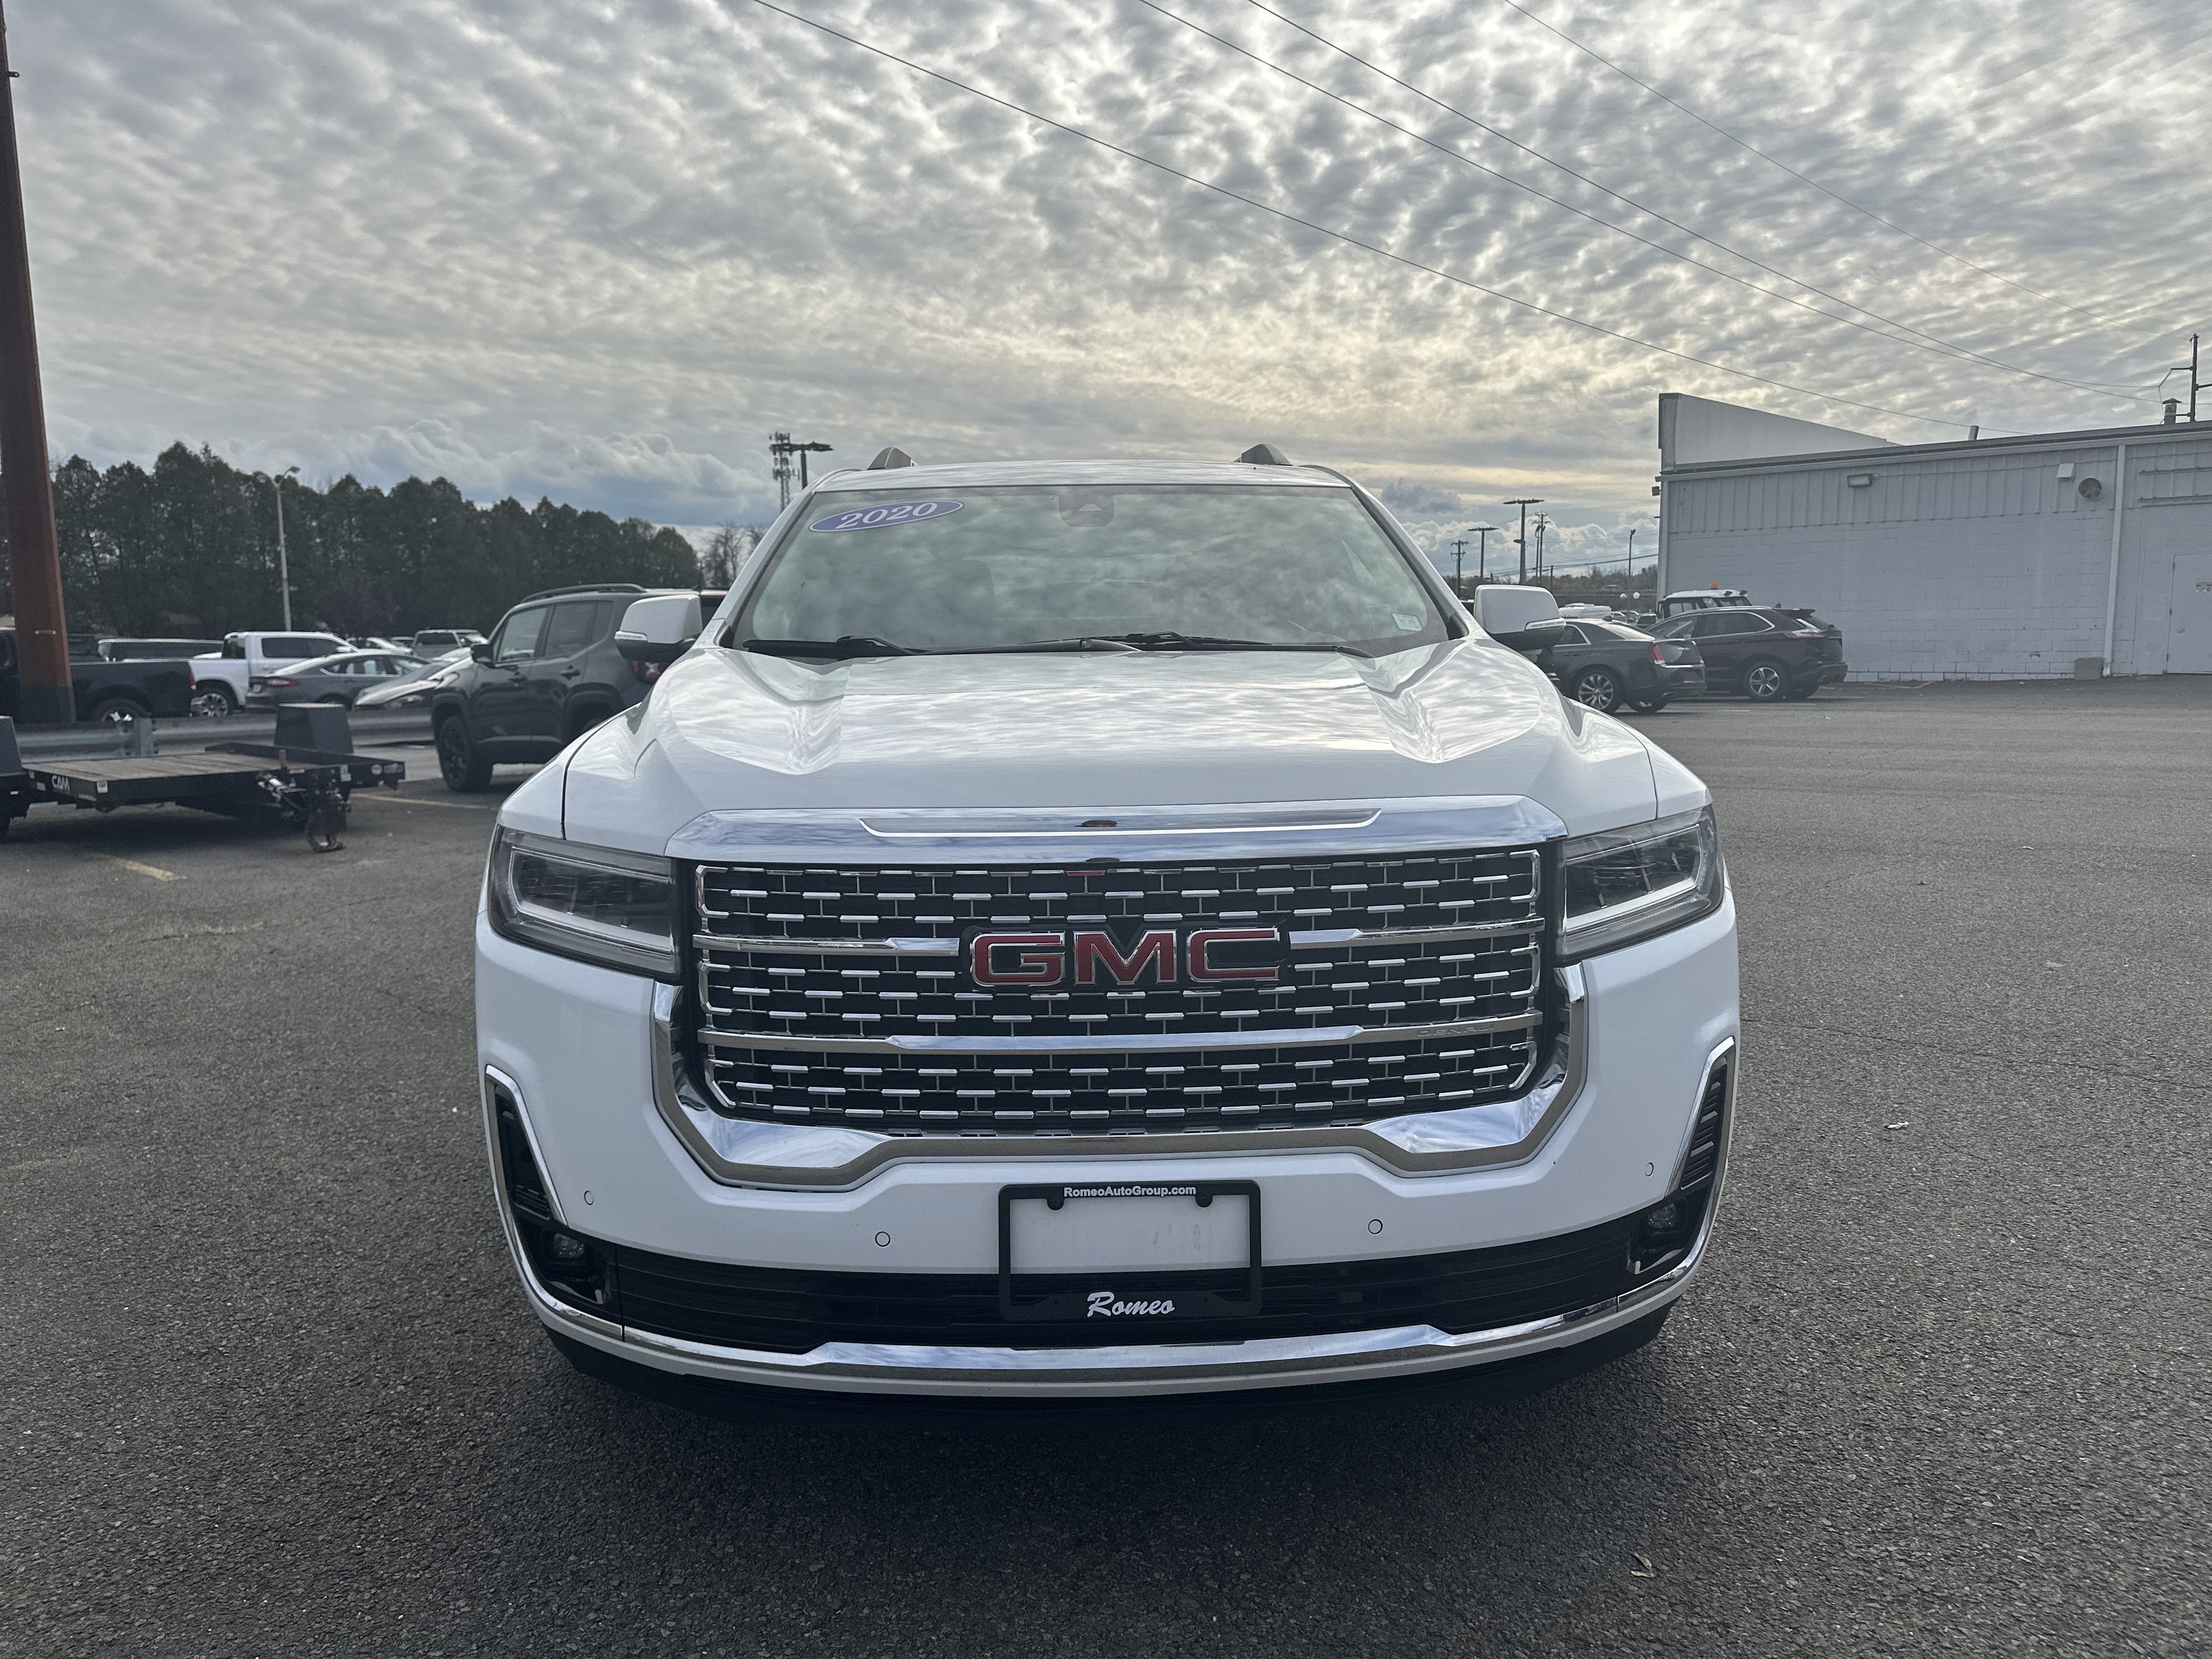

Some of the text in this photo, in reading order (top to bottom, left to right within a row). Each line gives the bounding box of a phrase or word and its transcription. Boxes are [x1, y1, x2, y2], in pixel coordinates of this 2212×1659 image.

[835, 503, 938, 529] 2020
[52, 775, 70, 792] CAM
[970, 928, 1280, 986] GMC
[1417, 1024, 1494, 1037] DENALI
[1064, 1186, 1197, 1197] RomeoAutoGroup.com
[1087, 1291, 1175, 1317] Romeo
